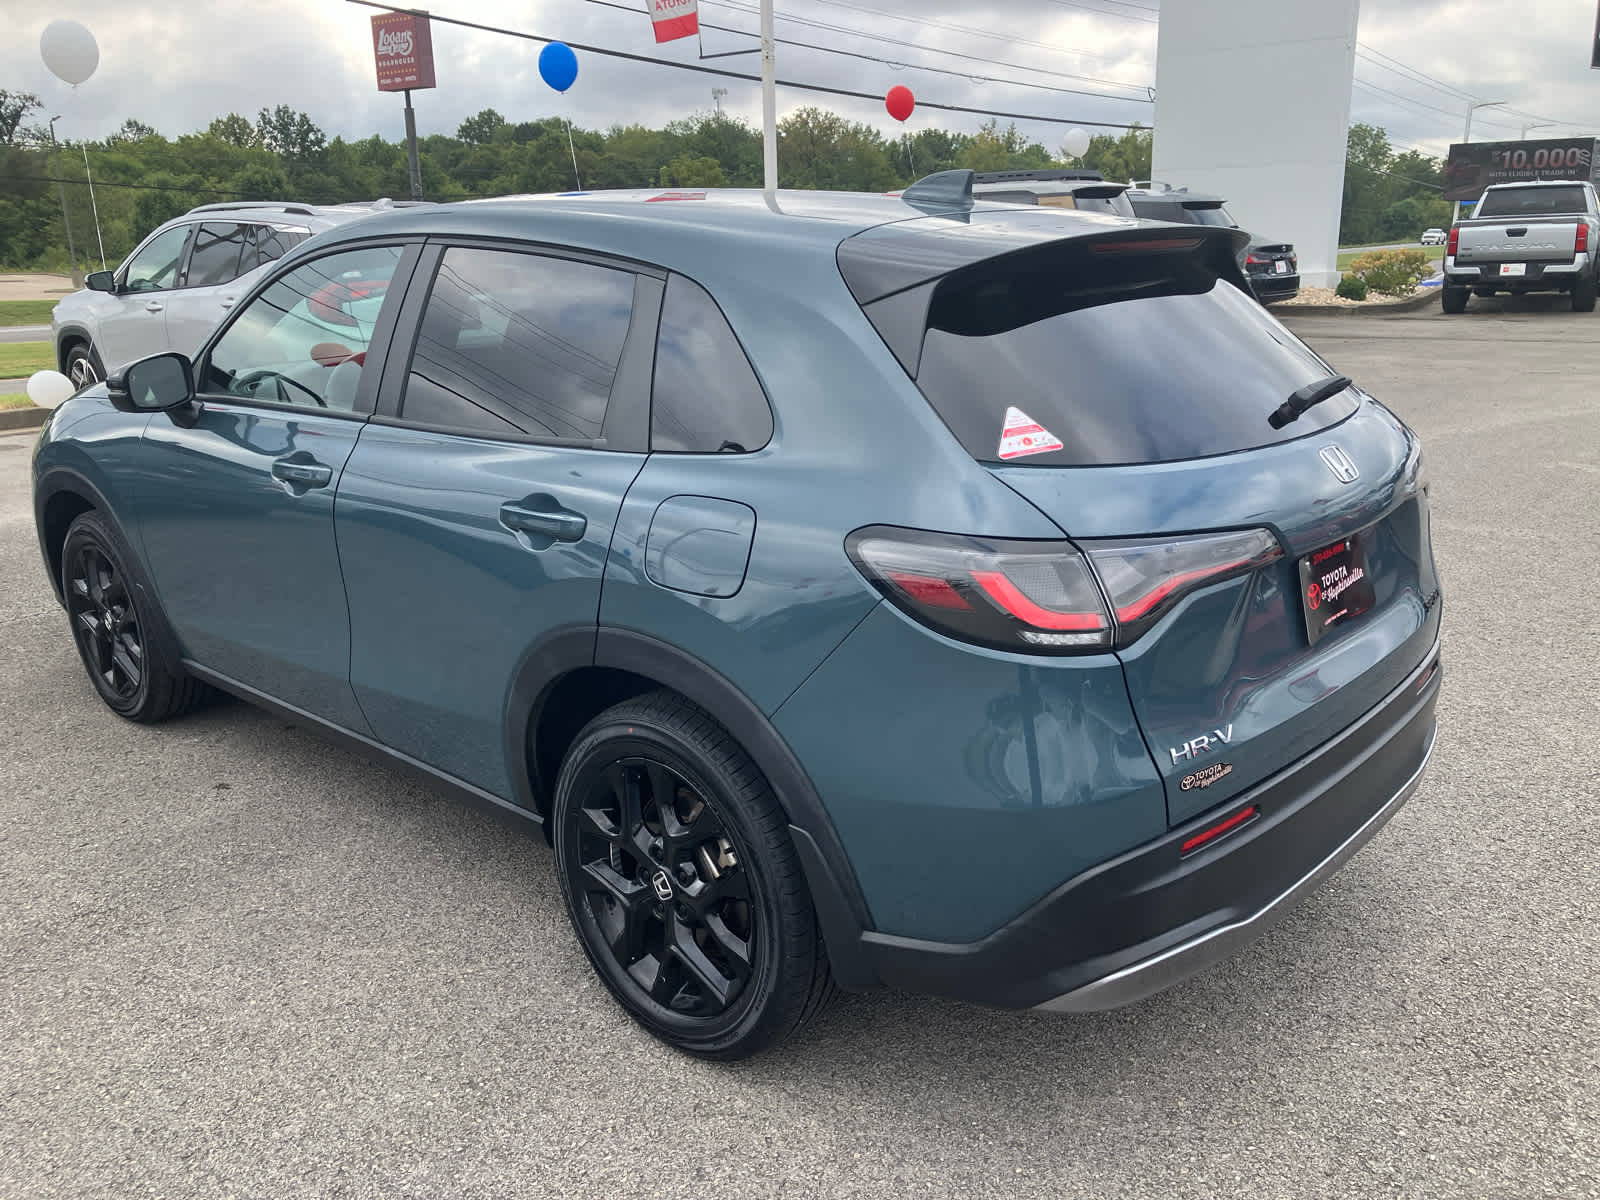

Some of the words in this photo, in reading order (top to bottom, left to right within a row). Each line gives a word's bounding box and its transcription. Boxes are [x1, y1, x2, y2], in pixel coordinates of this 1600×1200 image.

[1474, 239, 1557, 251] TACOMA
[1321, 564, 1348, 588] TOYOTA
[1326, 567, 1364, 602] Hopkinsville
[1169, 723, 1233, 766] HR-V
[1195, 763, 1222, 780] TOYOTA
